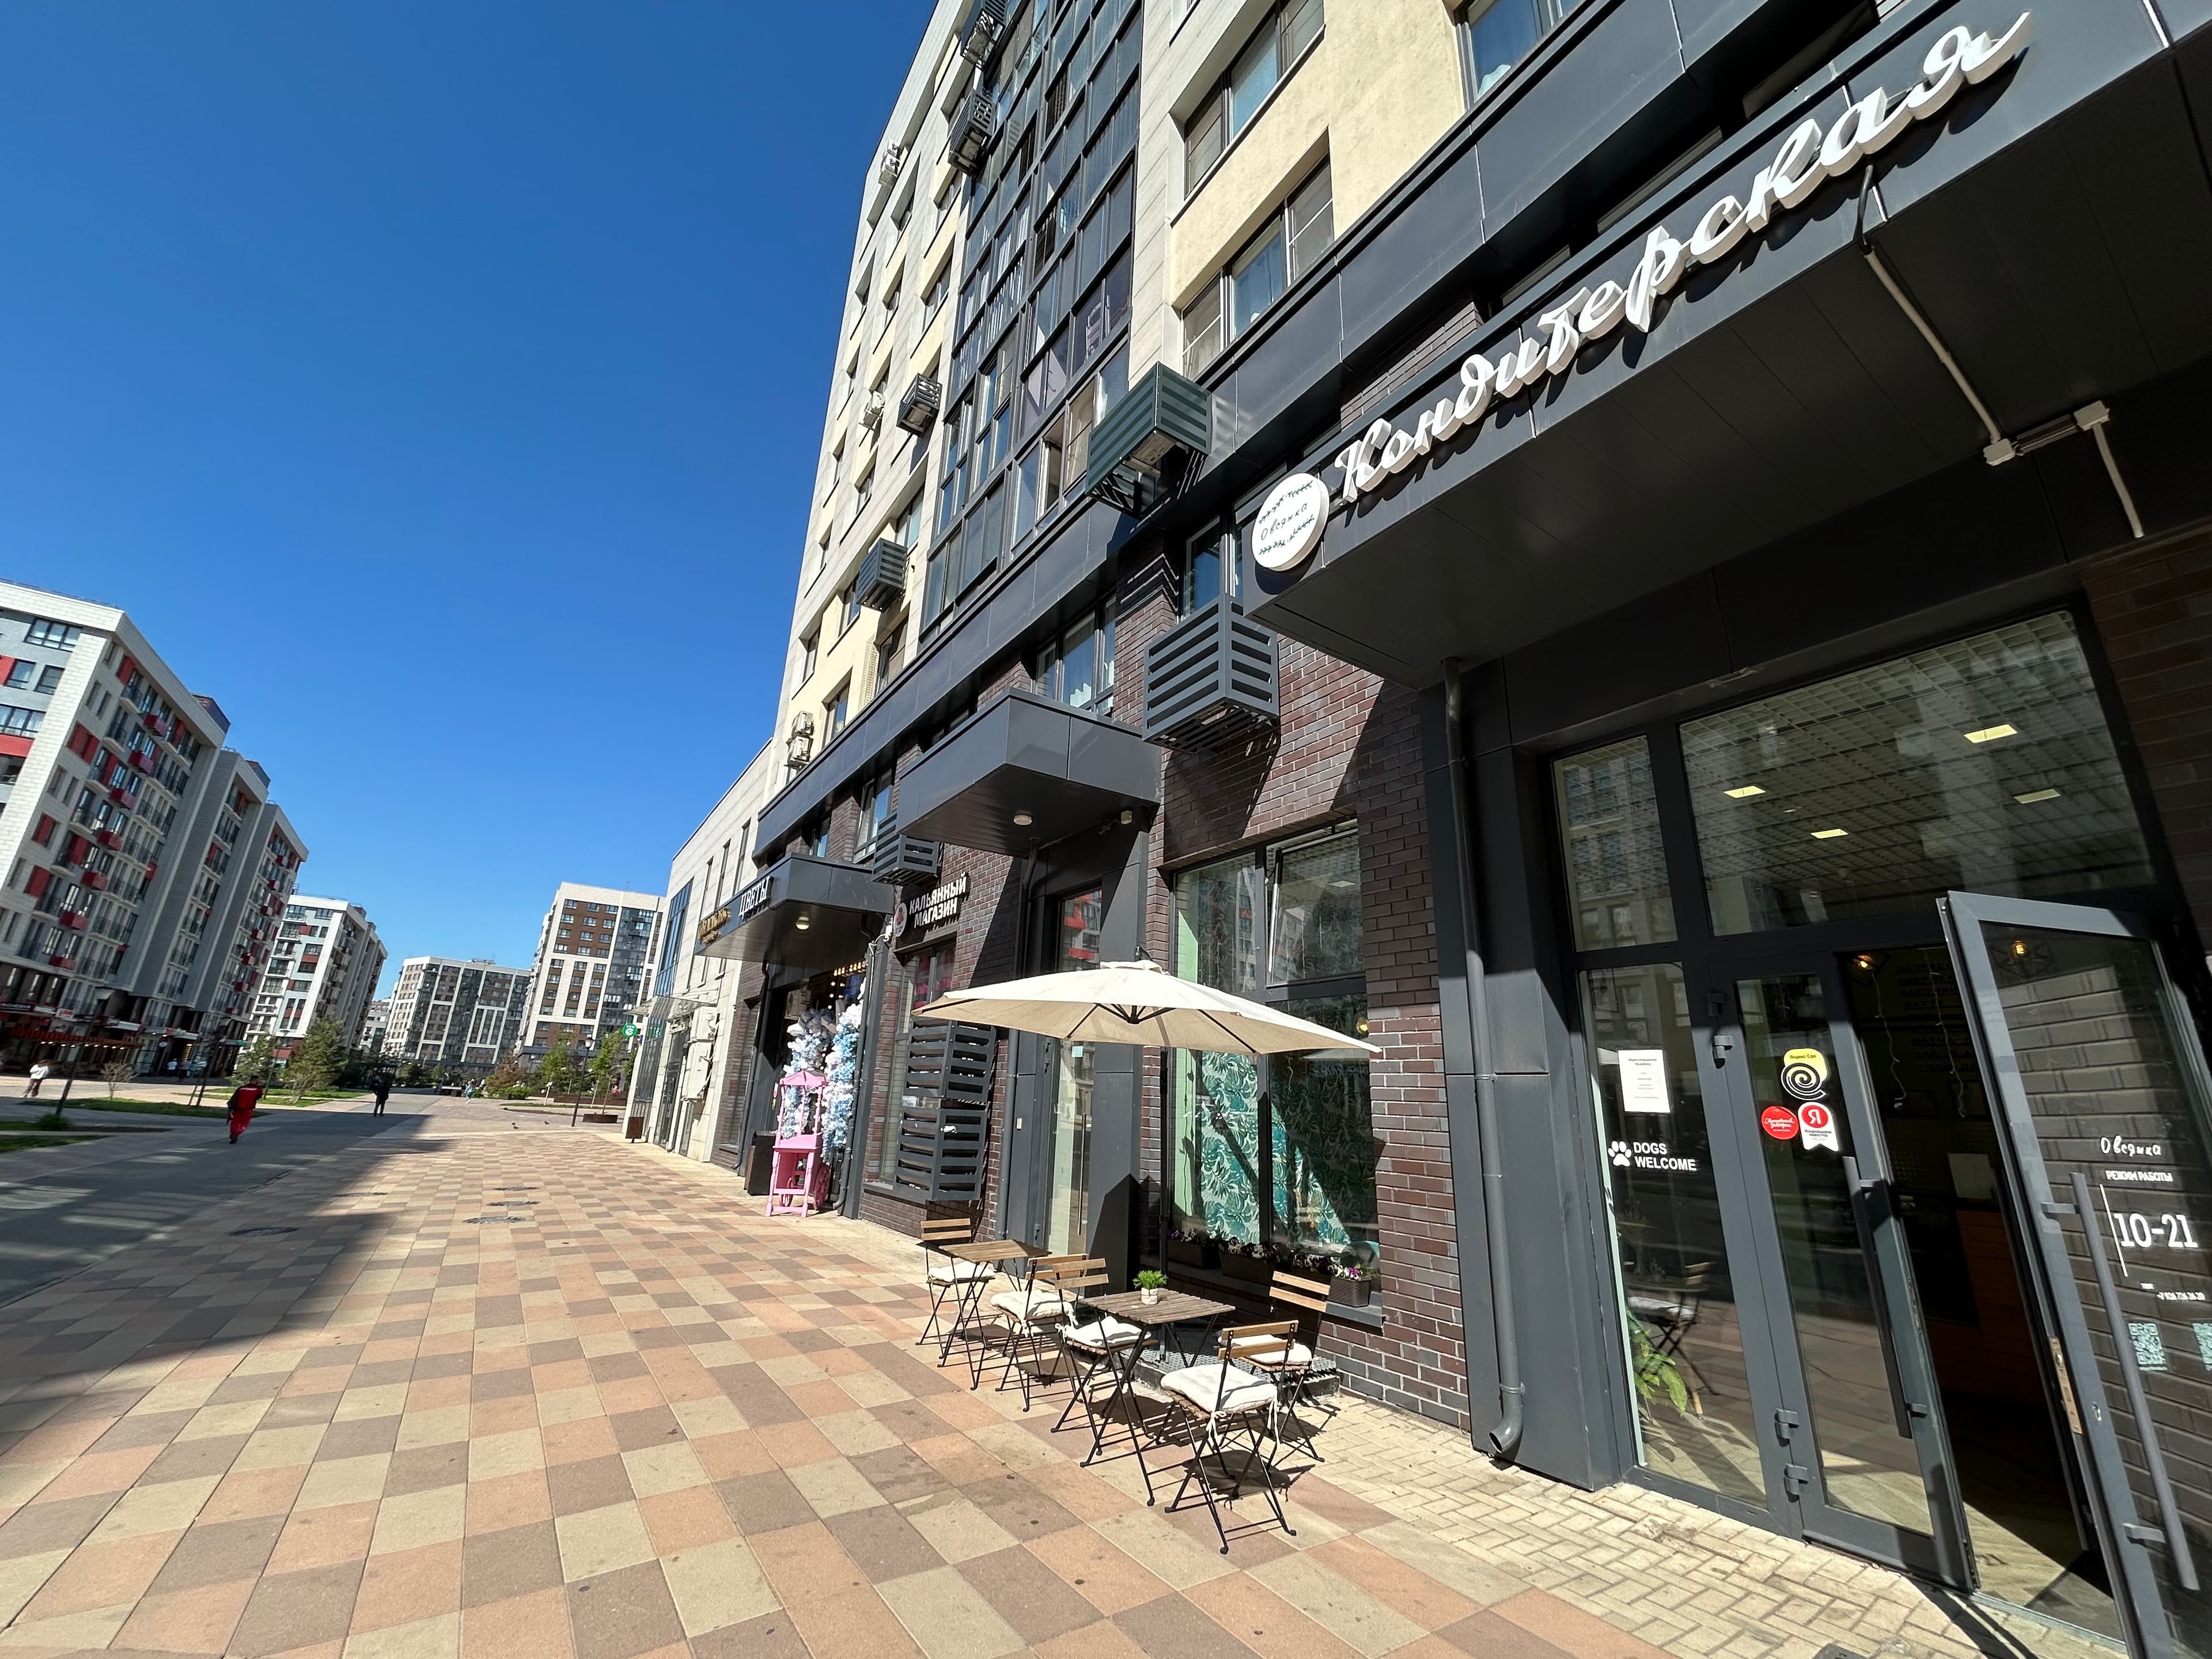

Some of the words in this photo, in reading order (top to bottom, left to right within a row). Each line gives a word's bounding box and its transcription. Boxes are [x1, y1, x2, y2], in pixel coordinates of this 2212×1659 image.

[1334, 10, 2032, 502] Кондитерская
[1261, 502, 1308, 541] Овсянка
[738, 876, 771, 919] ЦВЕТЫ
[909, 871, 967, 915] КАЛЬЯННЫЙ
[914, 897, 958, 929] МАГАЗИН
[1808, 1108, 1822, 1125] Я
[1633, 1142, 1668, 1155] DOGS
[2100, 1135, 2161, 1157] Овсянка
[1634, 1156, 1697, 1171] WELCOME
[2137, 1171, 2173, 1182] РАБОТЫ
[2113, 1213, 2199, 1248] 10-21
